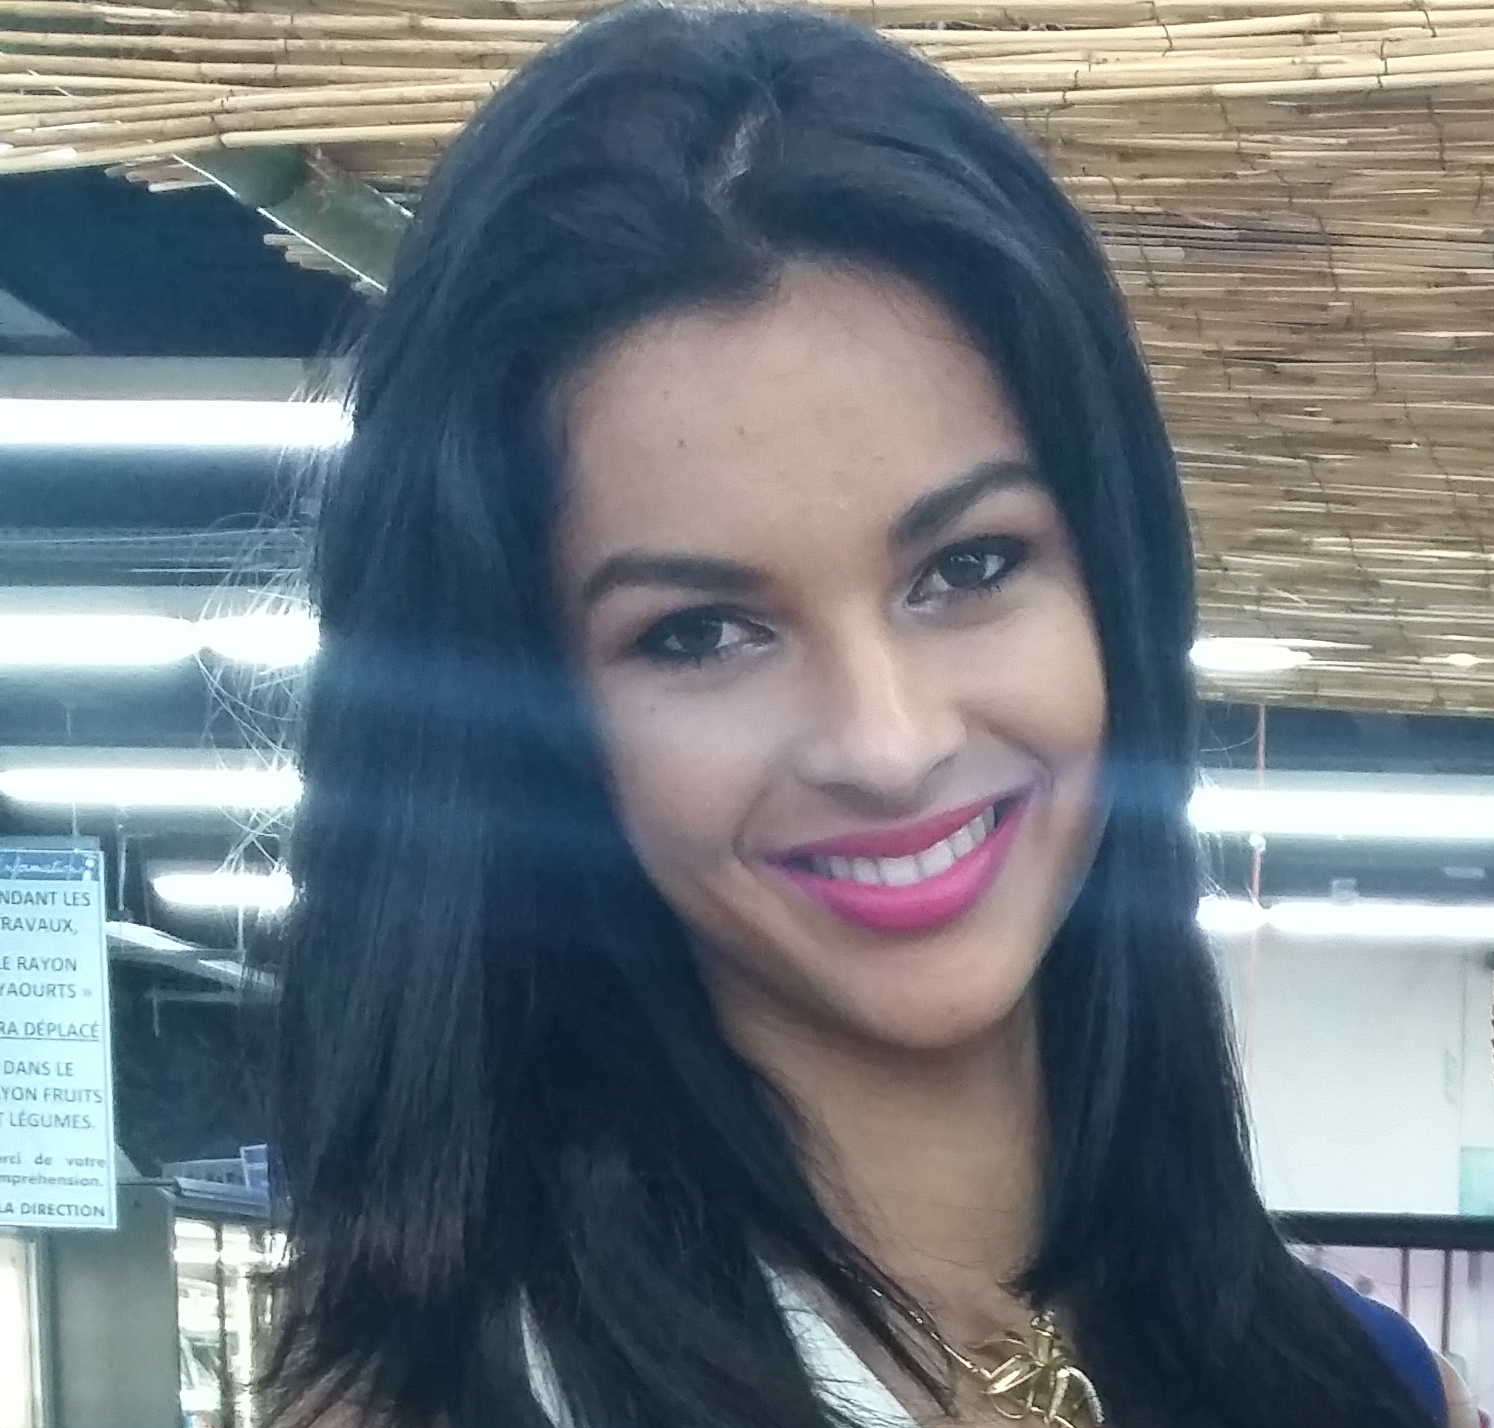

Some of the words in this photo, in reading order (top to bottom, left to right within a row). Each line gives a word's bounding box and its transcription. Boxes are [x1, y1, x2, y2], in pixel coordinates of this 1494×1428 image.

[64, 891, 91, 907] LES
[17, 956, 77, 972] RAYON
[24, 1017, 100, 1038] DÉPLACÉ
[3, 1060, 50, 1076] DANS
[57, 1062, 74, 1077] LE
[0, 1086, 37, 1101] YON
[43, 1088, 102, 1104] FRUITS
[34, 1152, 53, 1166] de
[67, 1155, 106, 1169] votre
[20, 1202, 105, 1218] DIRECTION
